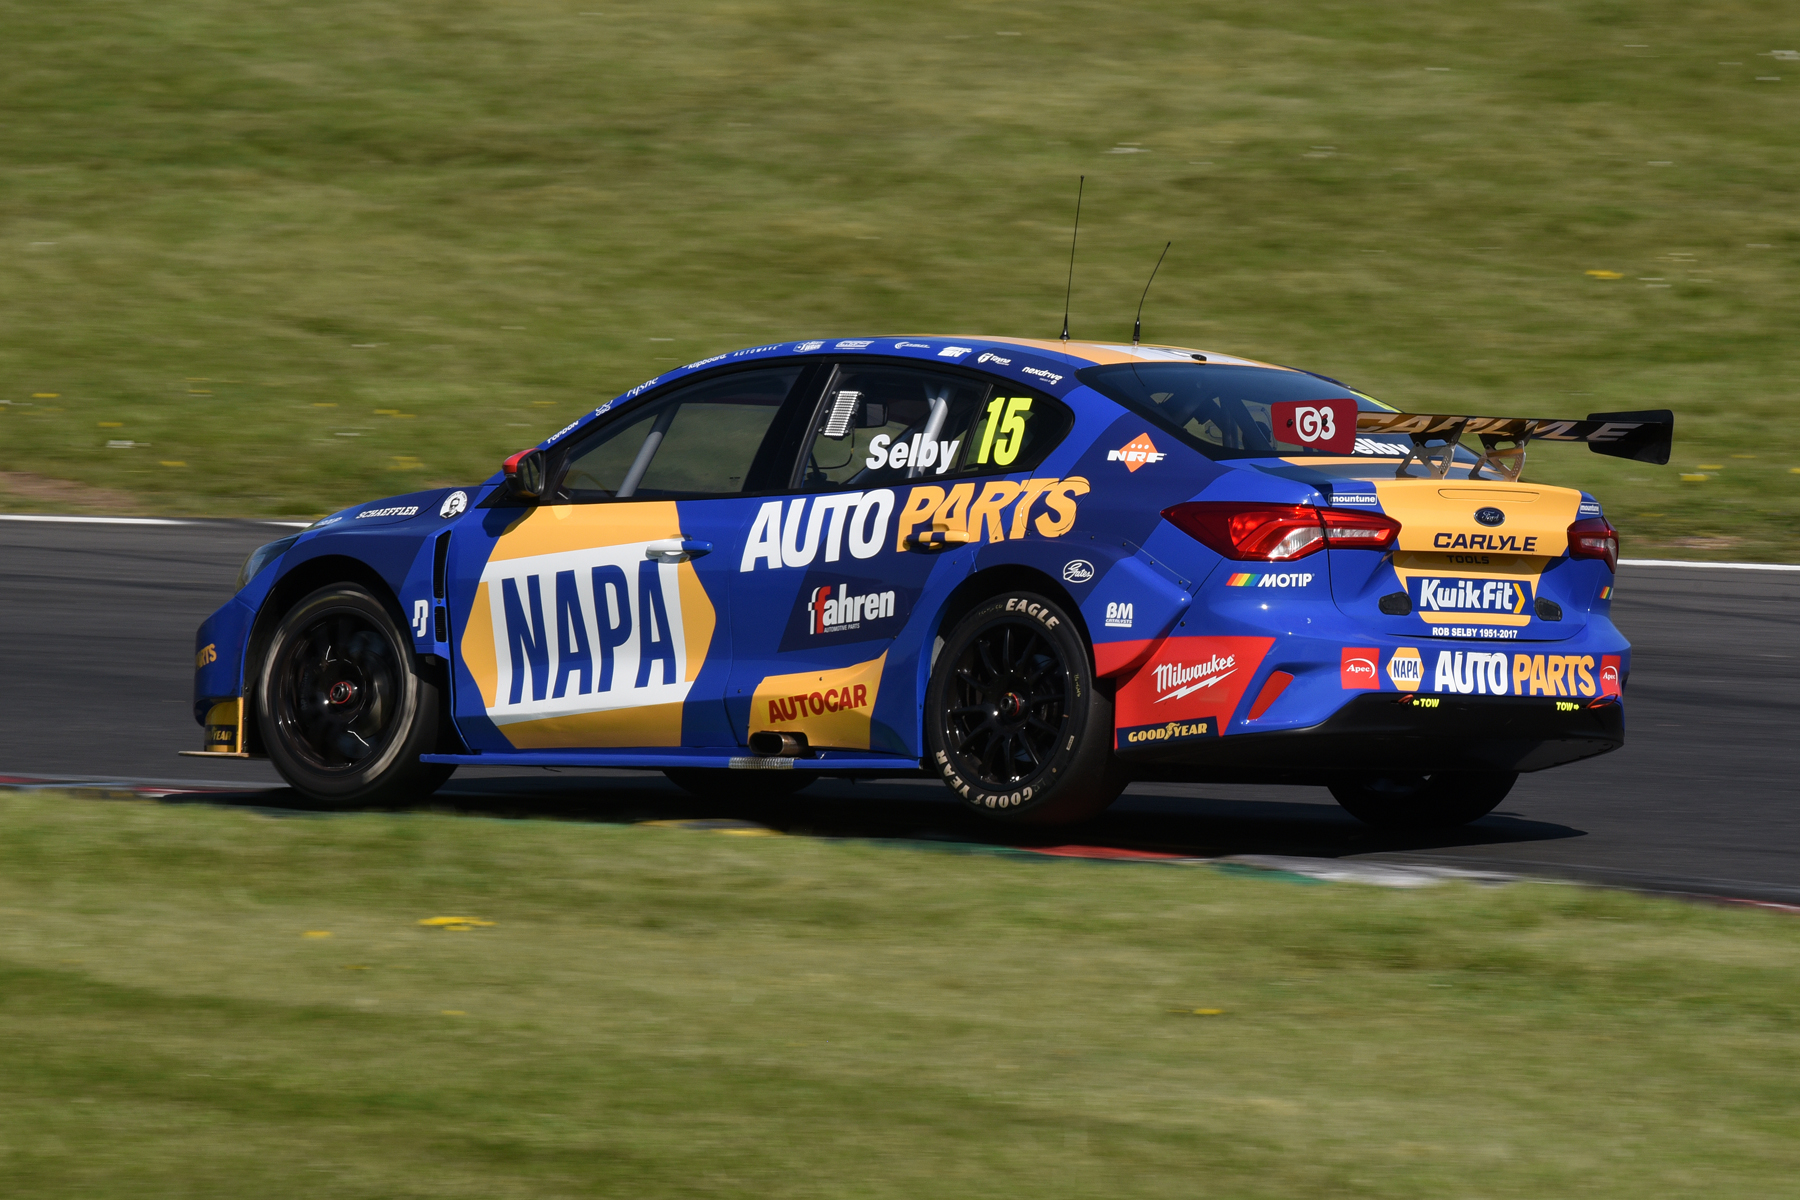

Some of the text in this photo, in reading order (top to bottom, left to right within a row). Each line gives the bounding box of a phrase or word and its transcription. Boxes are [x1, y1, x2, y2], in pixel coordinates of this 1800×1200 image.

[1022, 366, 1063, 381] nexdrive
[547, 421, 579, 444] TOPDON
[977, 397, 1032, 466] 15
[1295, 406, 1336, 442] G3
[866, 434, 960, 474] Selby
[1107, 450, 1166, 463] NRF
[1330, 492, 1376, 505] mountune
[355, 506, 419, 519] SCHAEFFLER
[740, 476, 1090, 573] AUTO PARTS
[1433, 532, 1538, 552] CARLYLE
[1446, 555, 1490, 565] TOOLS
[1064, 561, 1093, 581] Gates
[1258, 573, 1312, 588] MOTIP
[808, 583, 895, 635] fahren
[1005, 598, 1060, 631] EAGLE
[1106, 602, 1133, 620] BM
[501, 558, 676, 705] NAPA
[1432, 626, 1518, 639] ROB SELBY 1951-2017
[1151, 654, 1235, 693] Milwaukee
[1346, 663, 1371, 674] Apec
[1393, 660, 1419, 679] NAPA
[1434, 650, 1597, 697] AUTO PARTS
[1602, 671, 1616, 681] Apec
[768, 683, 867, 724] AUTOCAR
[1420, 698, 1440, 708] TOW
[1556, 701, 1574, 712] TOW
